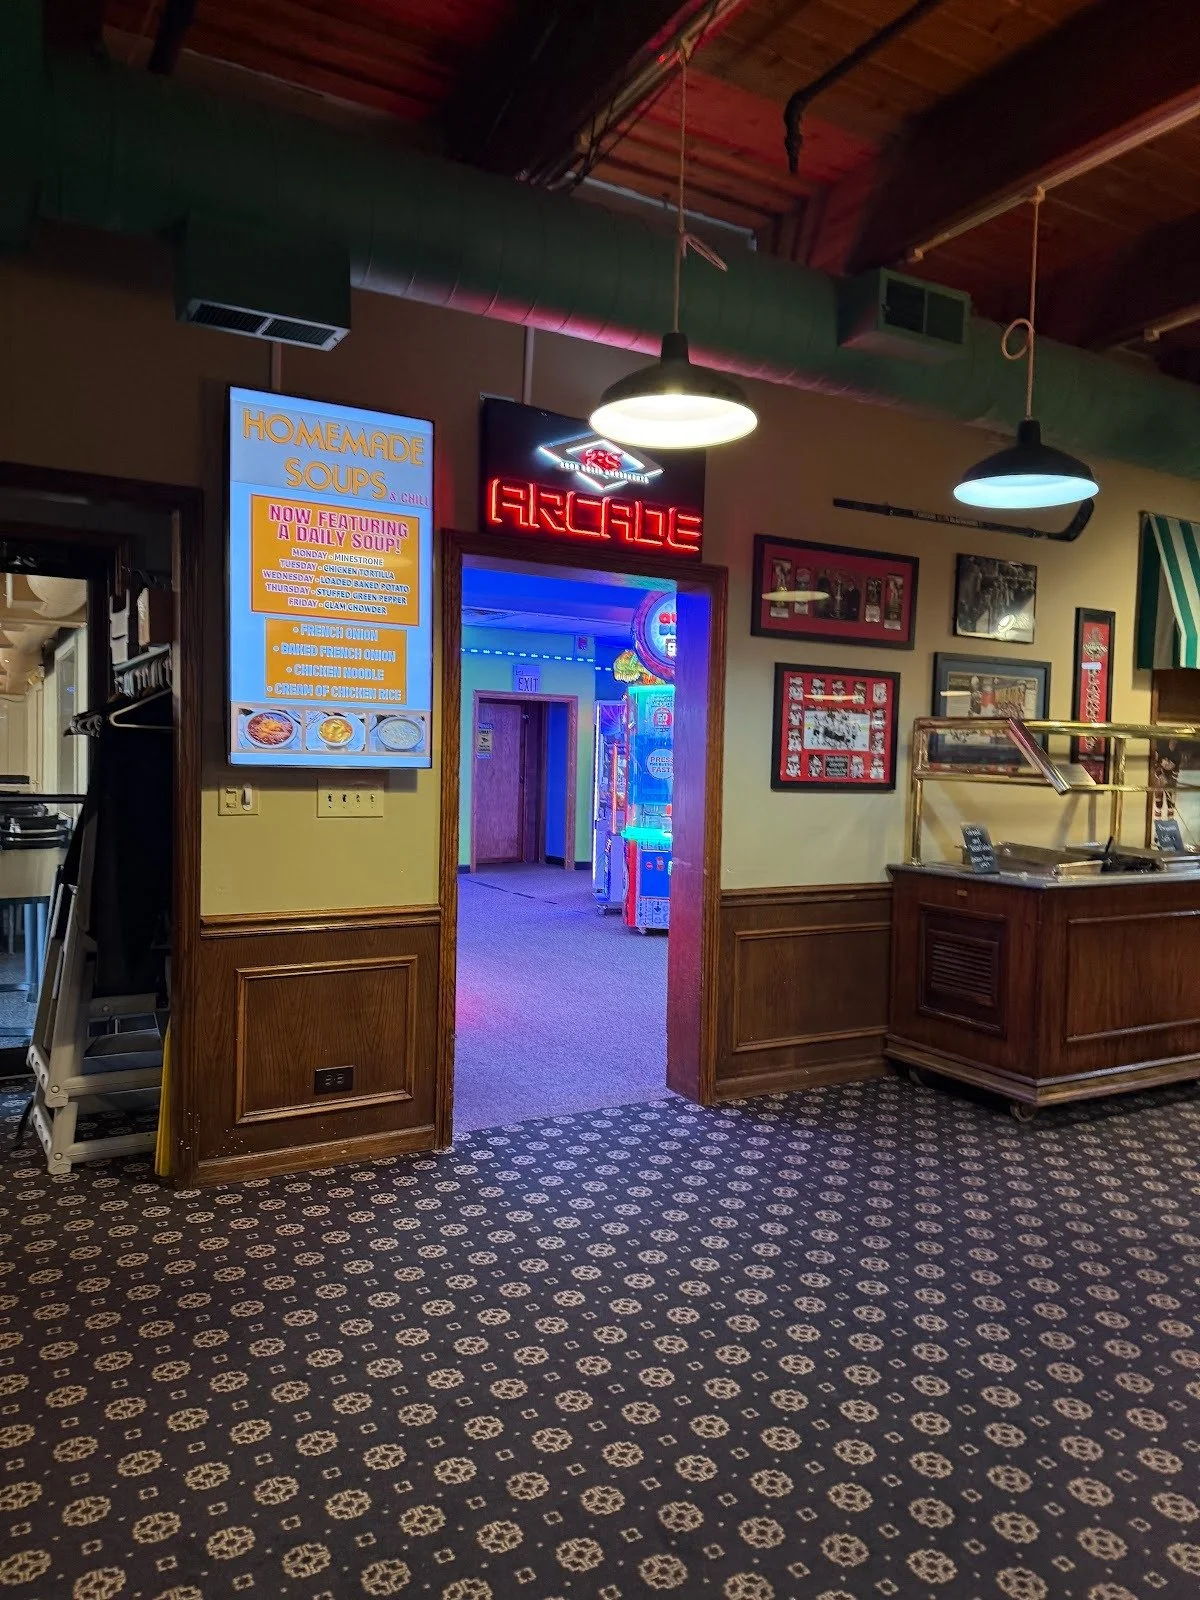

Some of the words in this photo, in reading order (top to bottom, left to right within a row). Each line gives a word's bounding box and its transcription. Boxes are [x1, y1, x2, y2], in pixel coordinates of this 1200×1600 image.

[243, 408, 425, 466] HOMEMADE
[284, 456, 388, 499] SOUPS
[269, 504, 311, 526] NOW
[318, 510, 409, 538] FEATURING
[490, 478, 703, 551] ARCADE
[278, 524, 290, 540] A
[297, 526, 346, 547] DAILY
[352, 533, 401, 554] SOUP!
[292, 548, 327, 560] MONDAY
[333, 553, 384, 566] MINESTRONE
[279, 559, 317, 571] TUESDAY
[323, 564, 358, 576] CHICKEN
[358, 568, 396, 580] TORTILLA
[262, 569, 314, 583] WEDNESDAY
[320, 576, 352, 587] LOADED
[353, 579, 380, 590] BAKED
[380, 582, 410, 593] POTATO
[265, 582, 310, 595] THURSDAY
[316, 588, 351, 600] STUFFED
[352, 591, 377, 602] GREEN
[378, 594, 407, 605] PEPPER
[288, 597, 318, 608] FRIDAY
[324, 601, 346, 611] CLAM
[347, 603, 387, 615] CHOWDER
[300, 623, 344, 639] FRENCH
[345, 627, 379, 642] ONION
[280, 642, 318, 657] BAKED
[319, 645, 362, 660] FRENCH
[363, 648, 396, 662] ONION
[293, 663, 342, 679] CHICKEN
[342, 666, 385, 681] NOODLE
[274, 682, 314, 697] CREAM
[315, 684, 330, 697] OF
[330, 685, 377, 700] CHICKEN
[378, 688, 402, 701] RICE
[518, 677, 539, 692] EXIT
